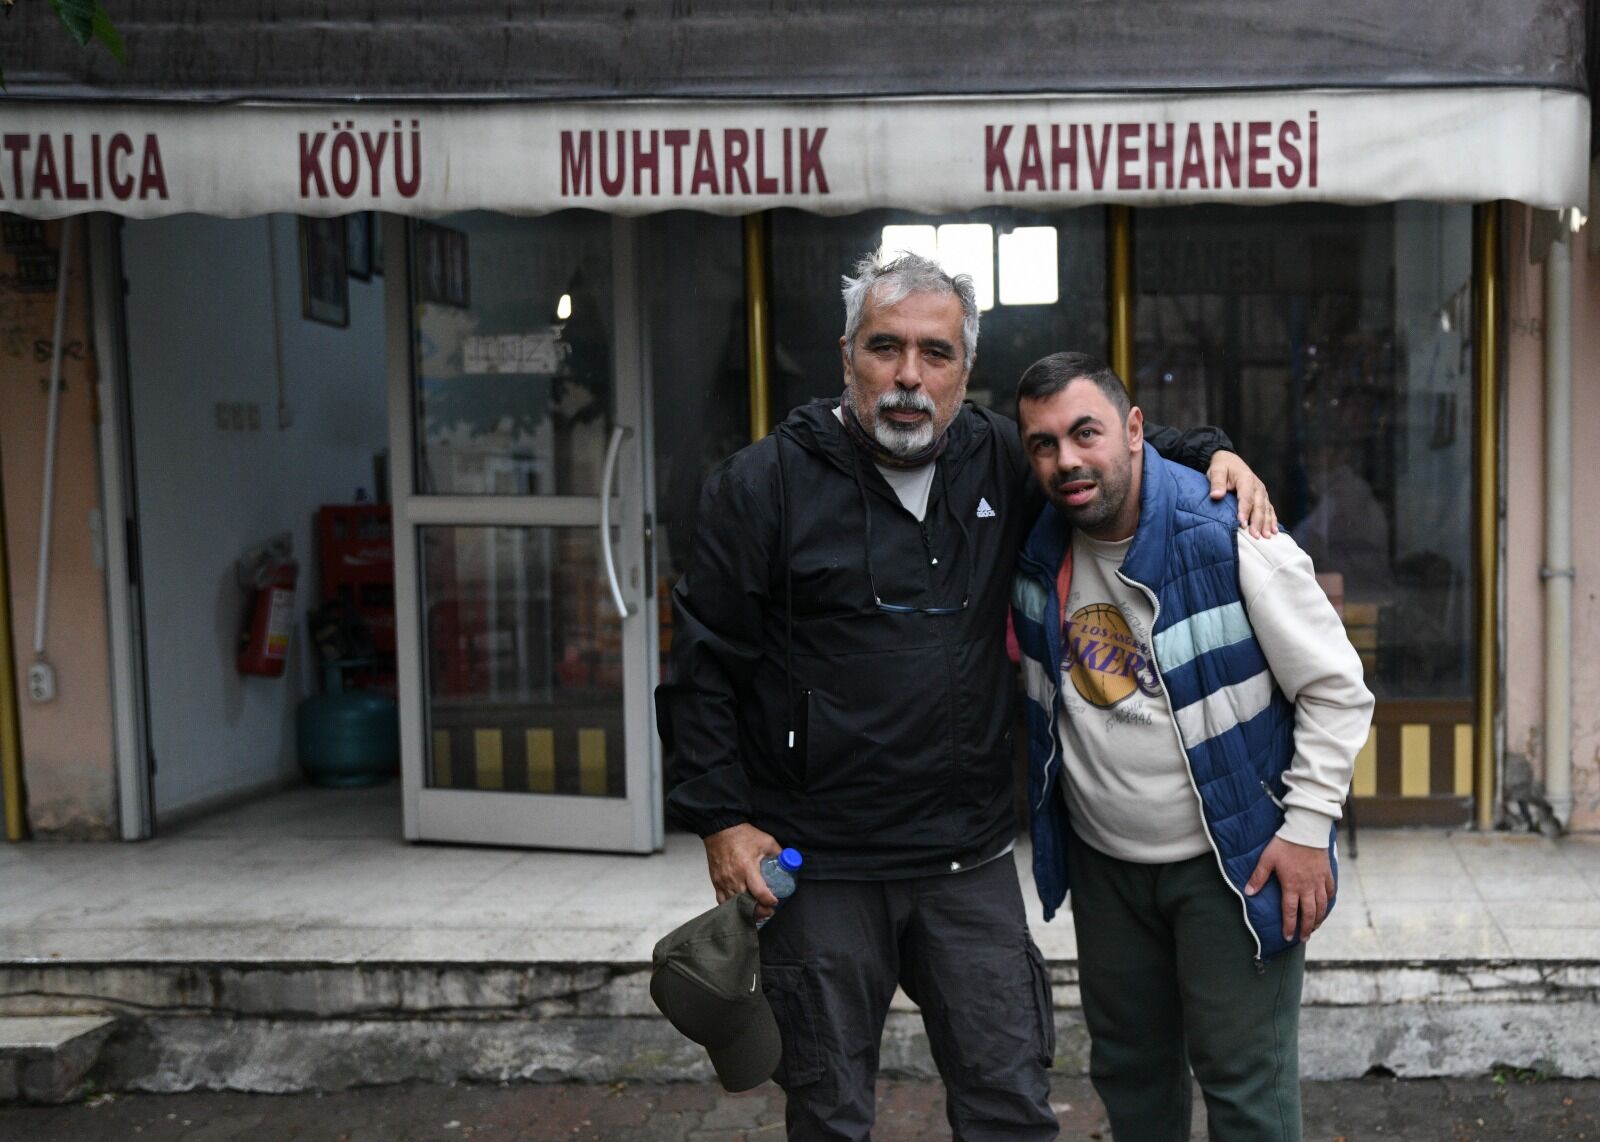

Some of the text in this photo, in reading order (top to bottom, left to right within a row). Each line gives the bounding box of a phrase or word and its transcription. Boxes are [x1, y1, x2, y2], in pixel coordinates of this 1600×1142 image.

[0, 110, 1319, 200] TALICA KÖYÜ MUHTARLIK KAHVEHANESİ
[1080, 624, 1109, 638] LOS
